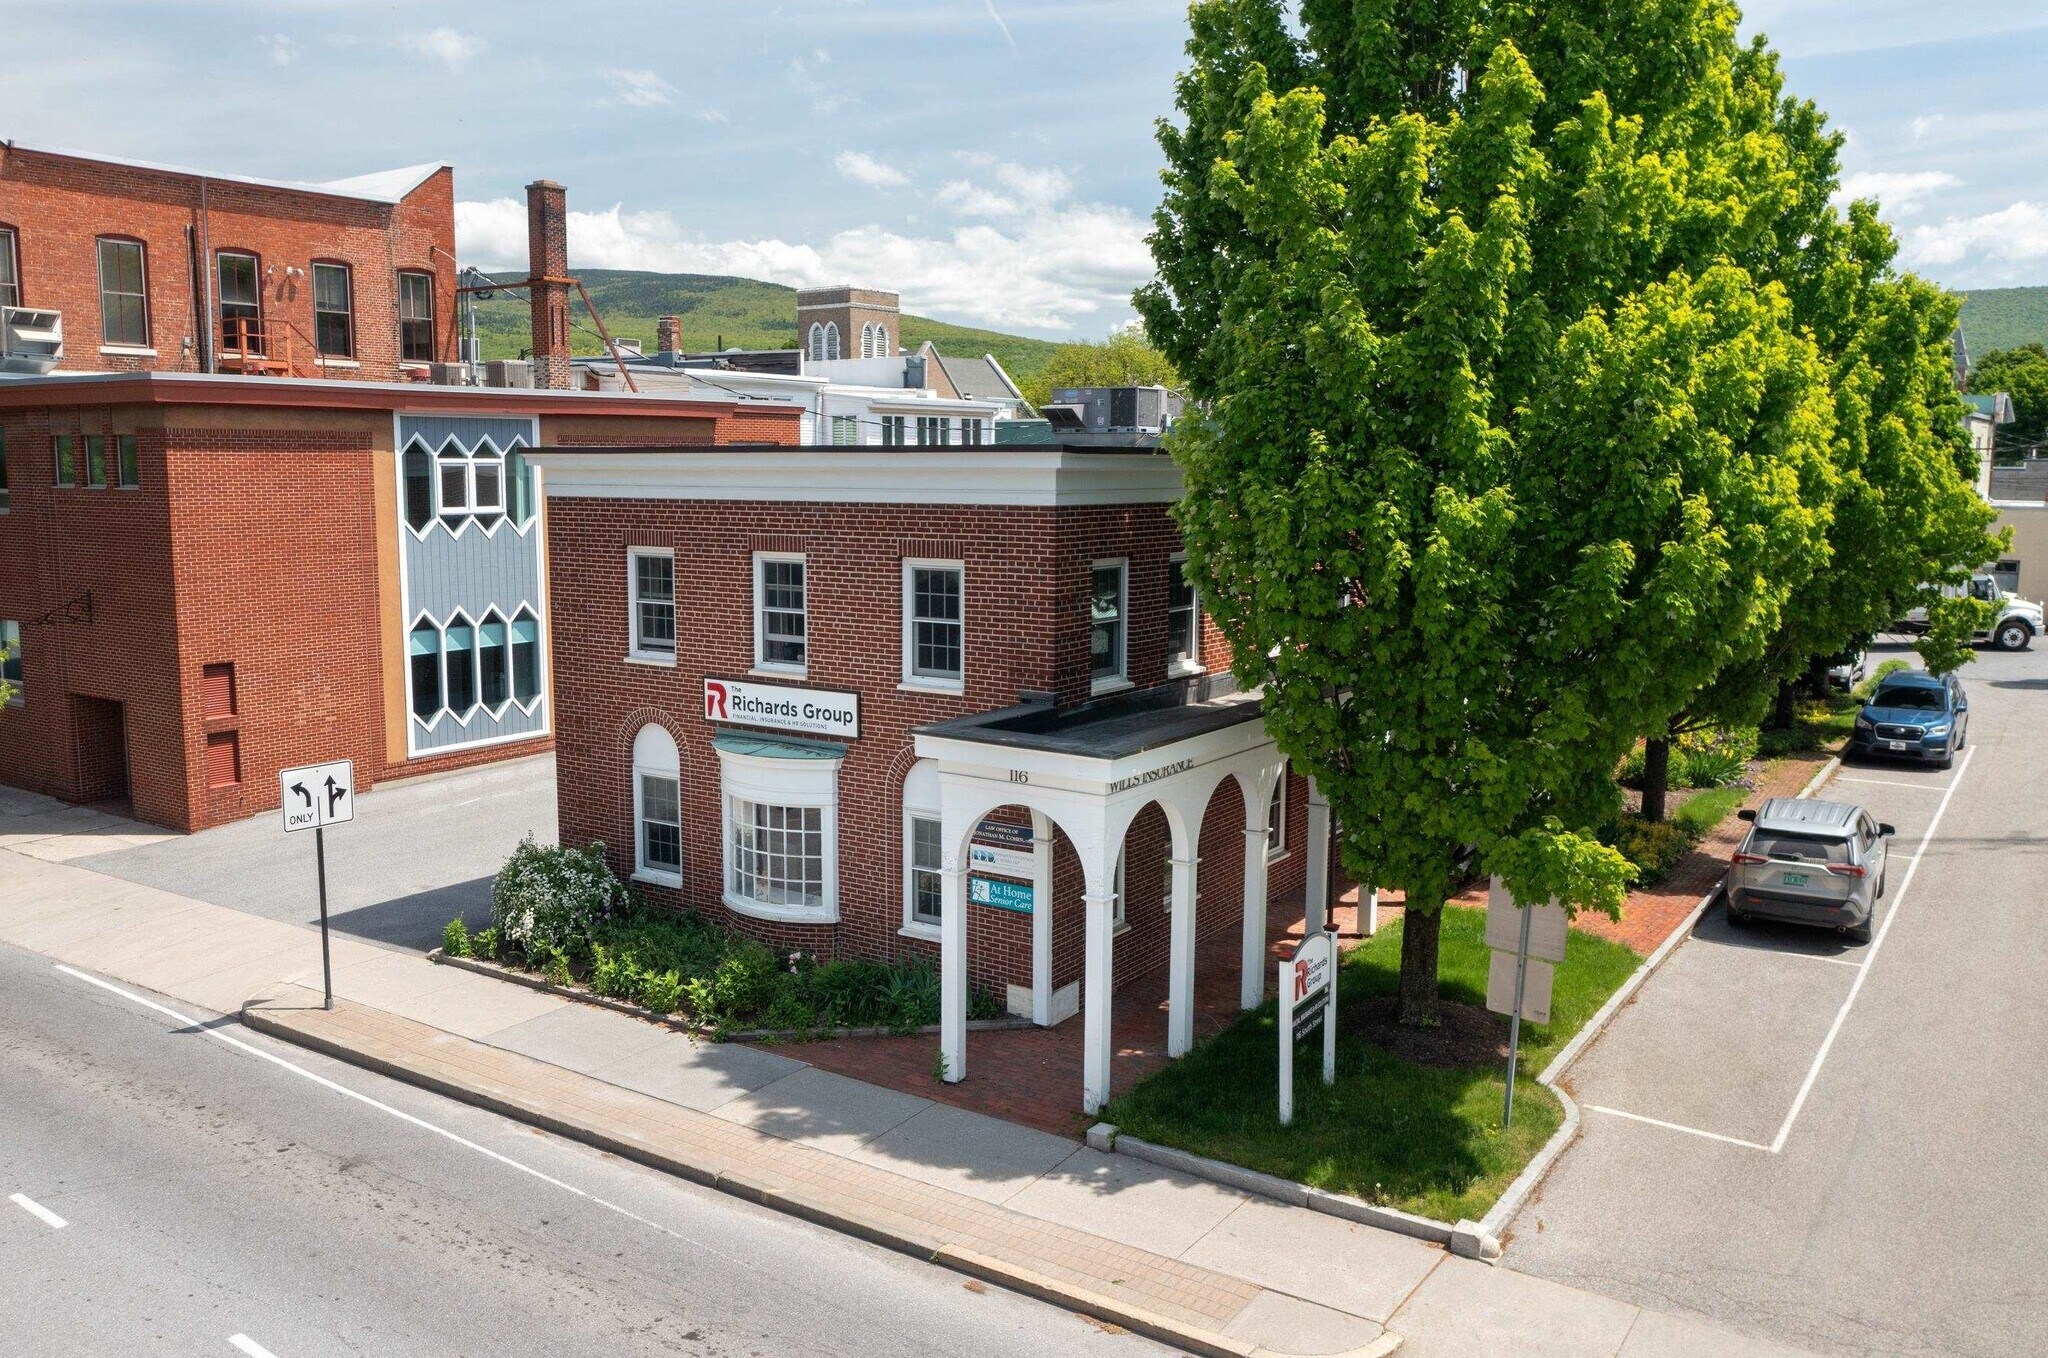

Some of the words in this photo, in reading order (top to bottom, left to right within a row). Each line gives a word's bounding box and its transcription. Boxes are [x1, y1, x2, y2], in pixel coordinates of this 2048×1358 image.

[731, 685, 742, 694] The
[732, 695, 798, 717] Richards
[803, 703, 854, 726] Group
[760, 717, 787, 726] INSURANCE
[800, 721, 828, 730] SOLUTIONS
[1009, 769, 1028, 784] 116
[1110, 775, 1140, 793] WILLS
[1142, 759, 1194, 783] INSURANCE
[289, 812, 314, 825] ONLY
[990, 884, 1001, 895] At
[1003, 885, 1032, 900] Home
[990, 894, 1013, 906] Senior
[1014, 898, 1032, 909] Care
[1307, 956, 1328, 975] Richards
[1307, 972, 1322, 987] Group
